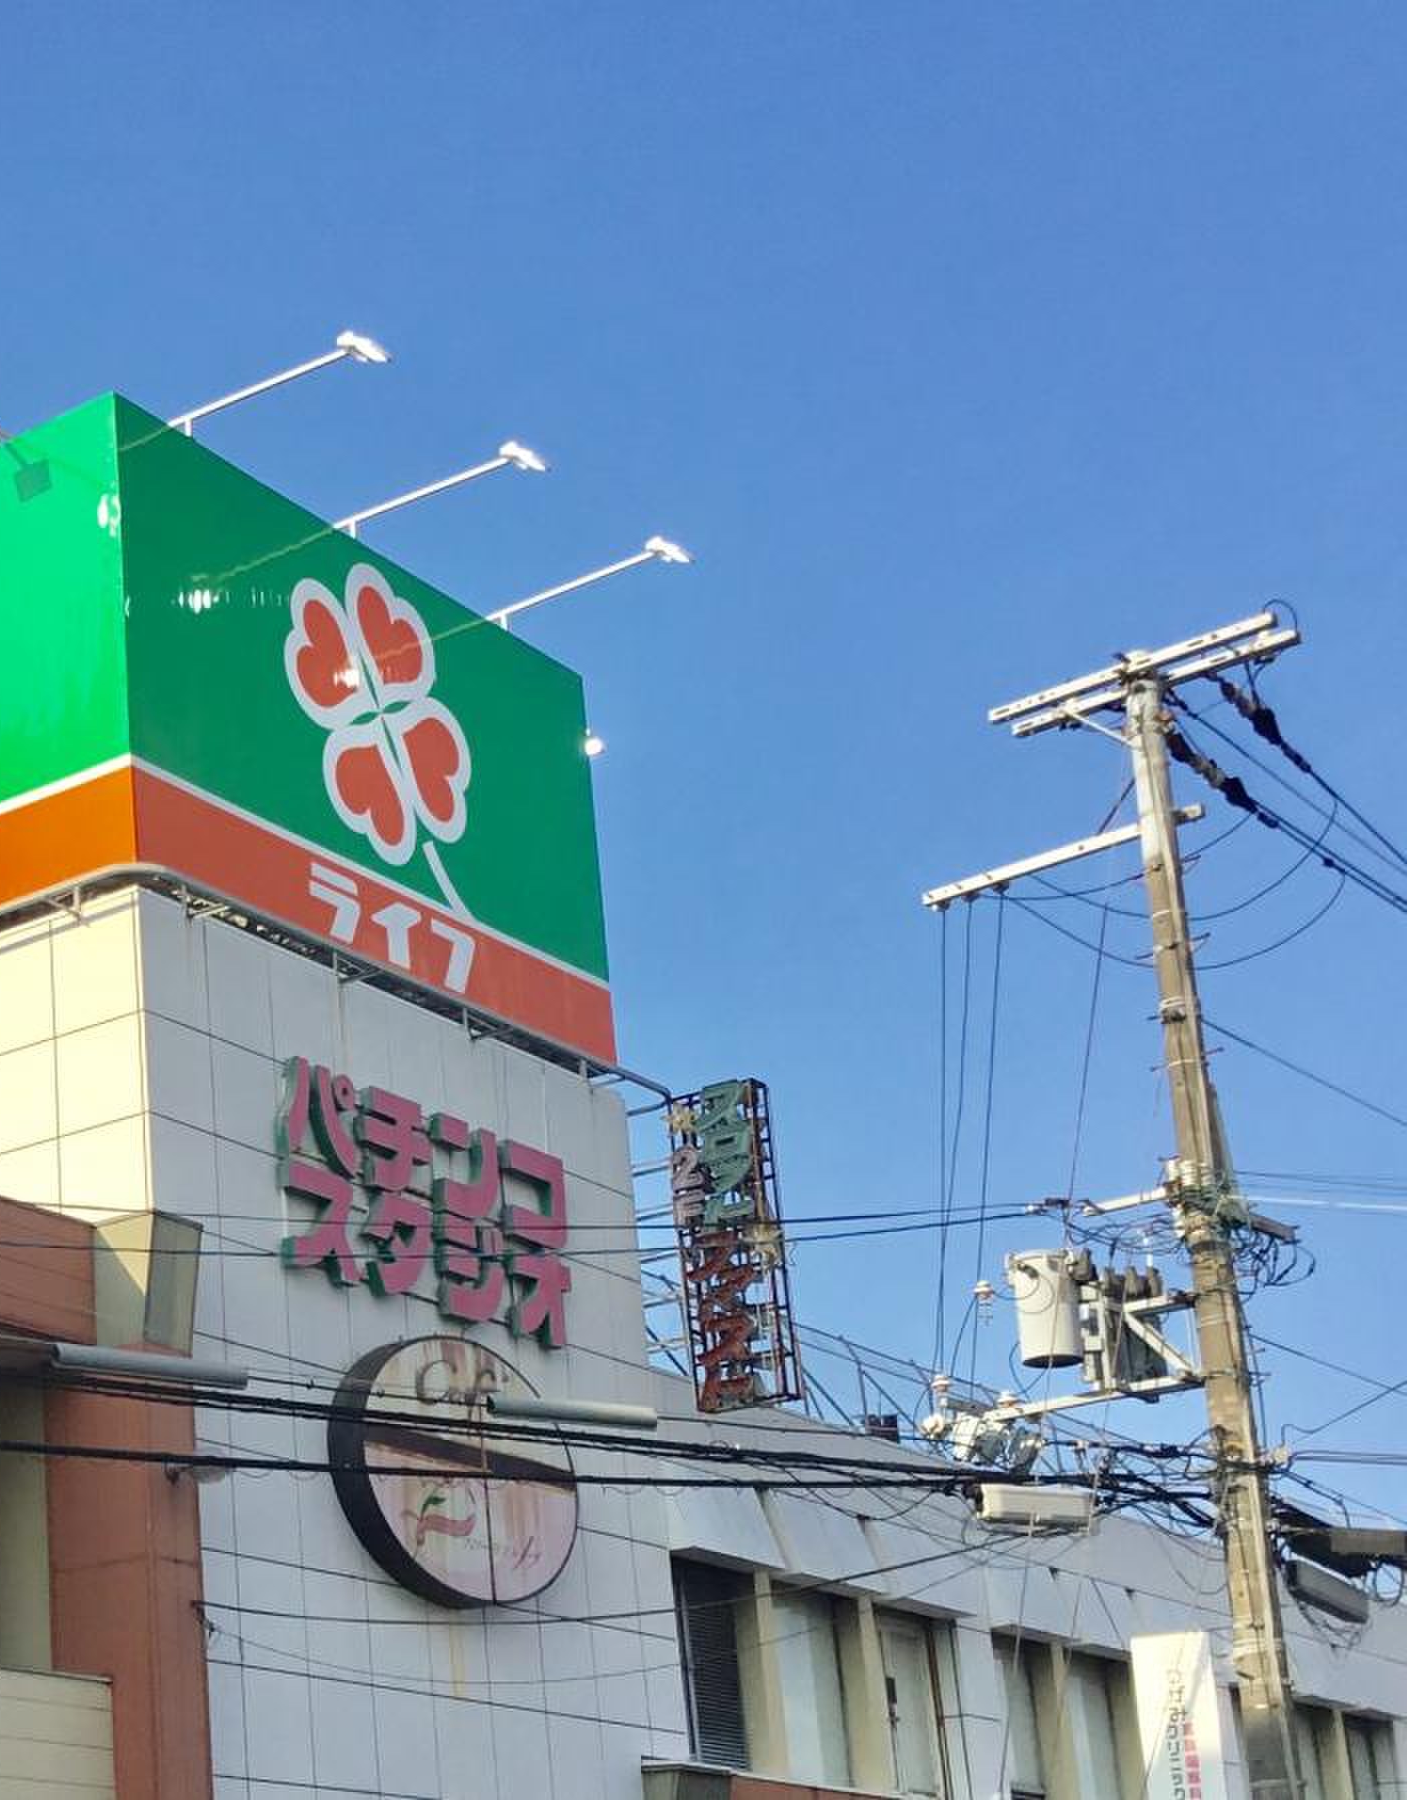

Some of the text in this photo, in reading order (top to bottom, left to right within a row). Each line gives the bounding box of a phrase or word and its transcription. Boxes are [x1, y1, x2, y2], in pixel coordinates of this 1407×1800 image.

[308, 862, 475, 994] ライフ
[277, 1056, 568, 1250] パチンコ
[277, 1163, 571, 1350] スタジオ
